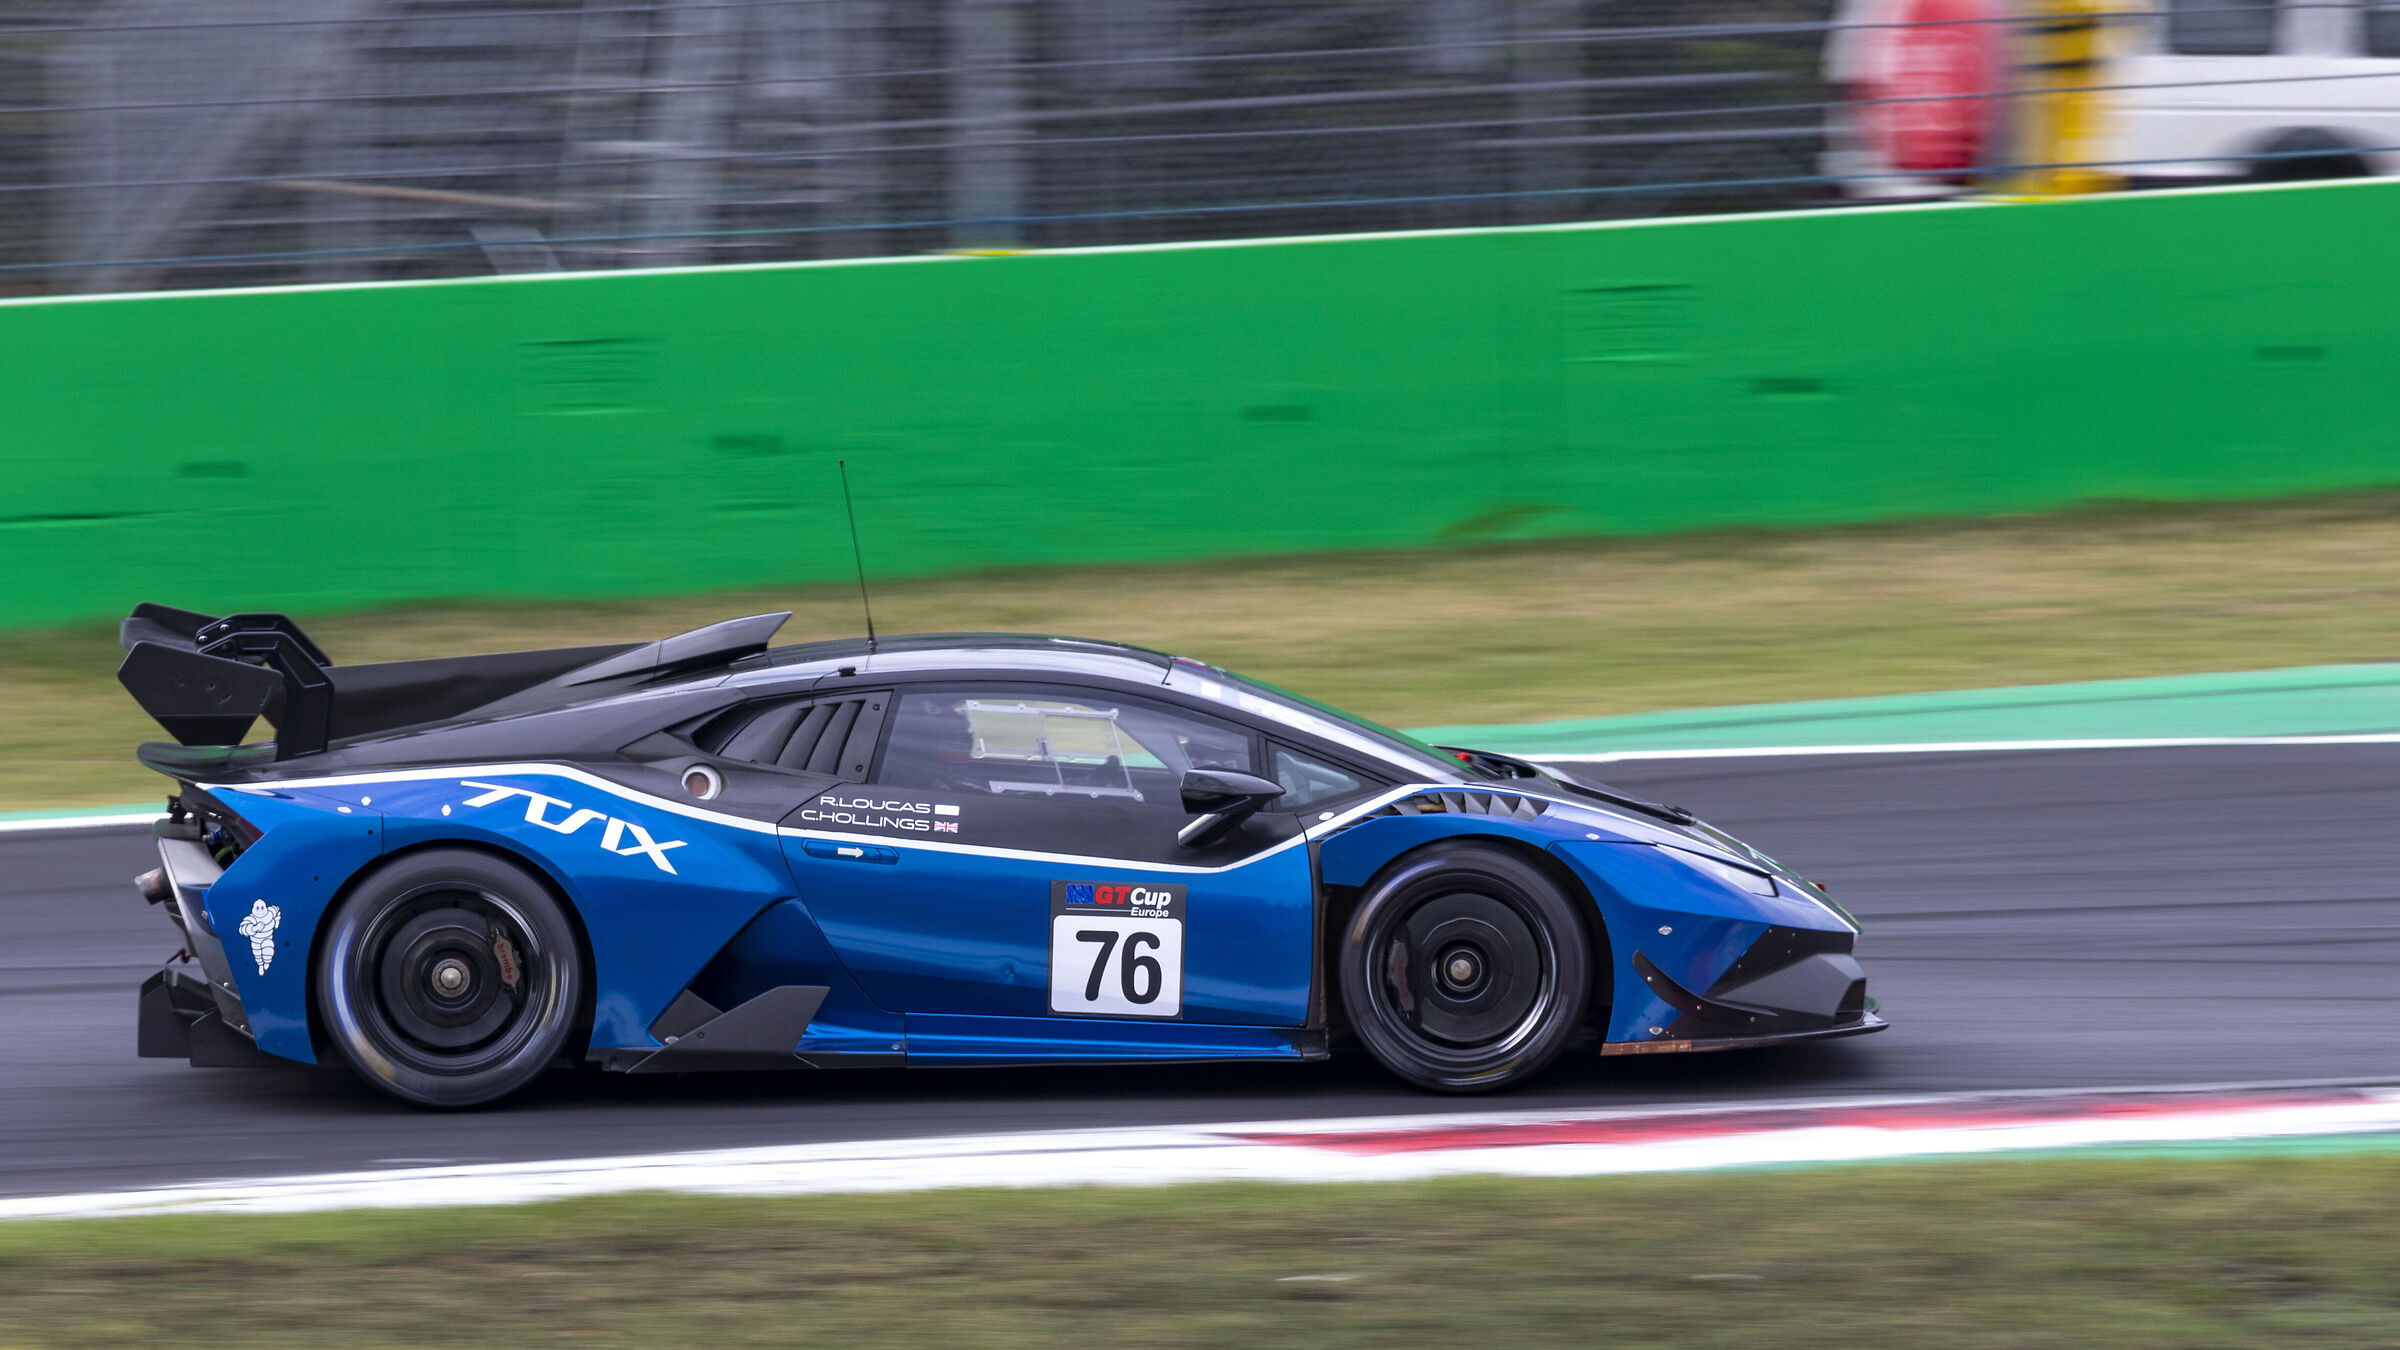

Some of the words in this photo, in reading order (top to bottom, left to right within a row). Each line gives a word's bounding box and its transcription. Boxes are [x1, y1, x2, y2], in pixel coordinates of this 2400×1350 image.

[820, 796, 931, 814] R.LOUCAS
[801, 810, 931, 832] C.HOLLINGS
[1130, 907, 1170, 919] Europe
[1075, 930, 1163, 1005] 76
